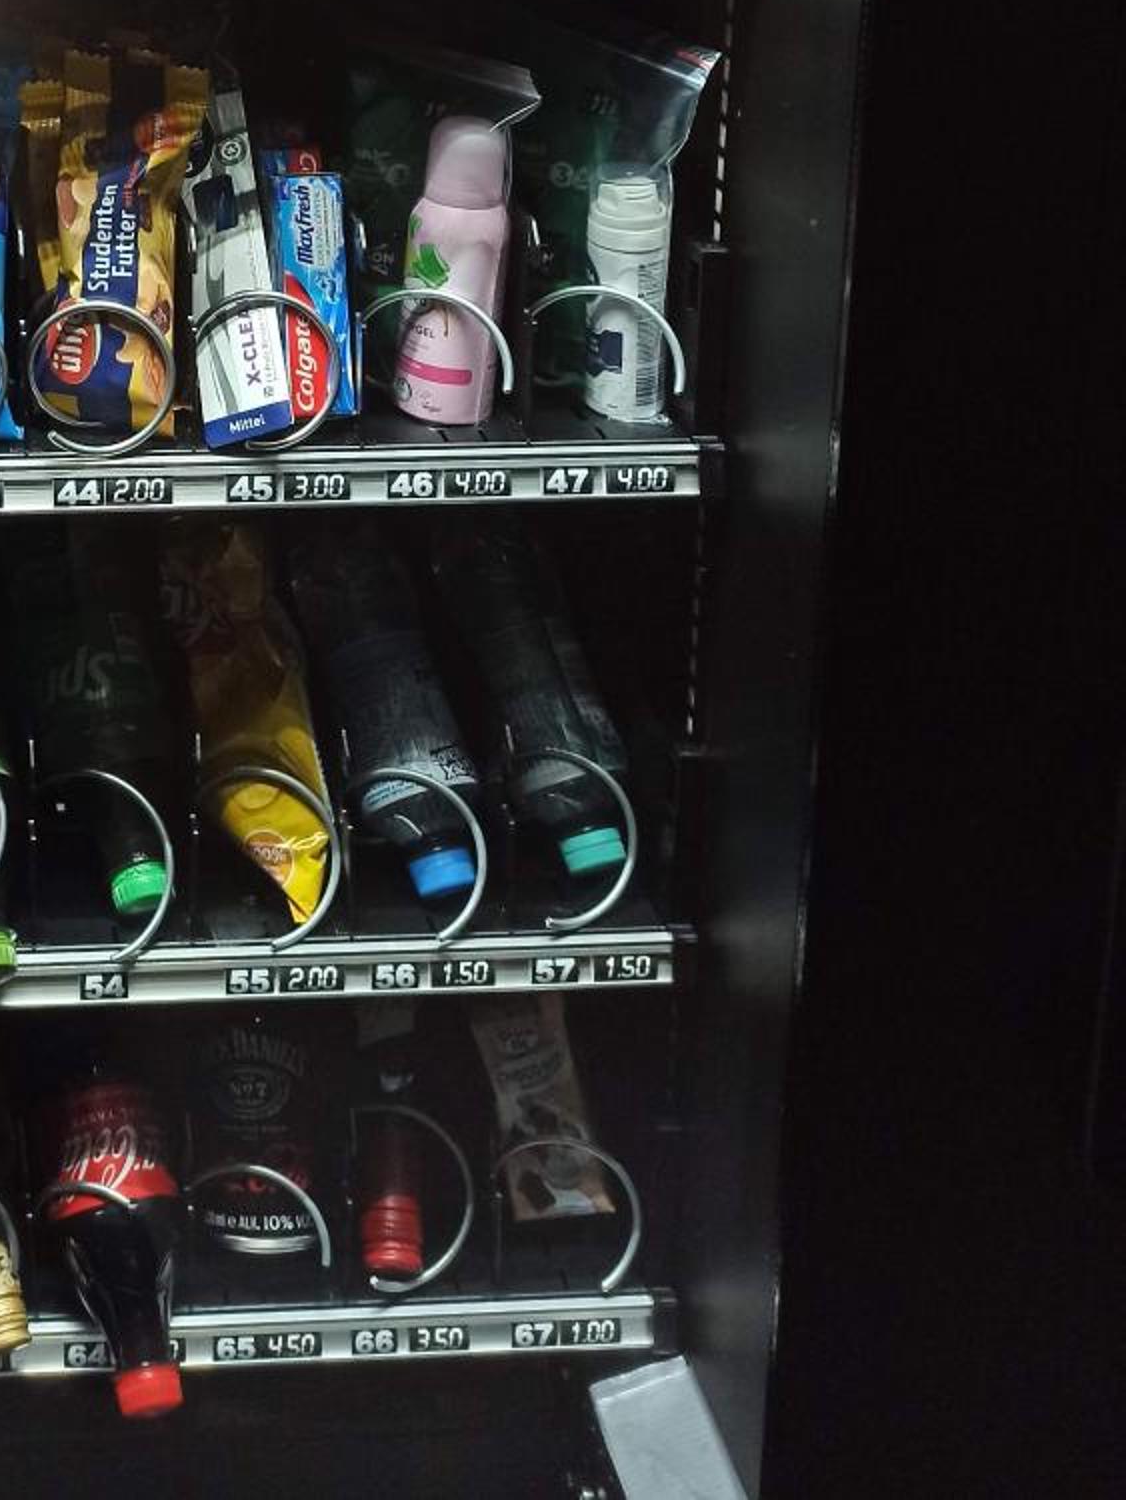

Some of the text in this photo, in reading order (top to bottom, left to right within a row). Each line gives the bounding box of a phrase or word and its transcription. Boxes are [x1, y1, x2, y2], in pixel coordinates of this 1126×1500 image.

[87, 183, 119, 294] Studenten
[111, 208, 138, 278] Futter
[294, 312, 316, 415] Colgate
[228, 414, 267, 436] Mittel
[57, 476, 166, 505] 44 2.00
[229, 473, 345, 501] 45 3.00
[390, 469, 506, 498] 46 4.00
[546, 466, 668, 494] 47 4.00
[229, 966, 339, 994] 55 2.00
[375, 961, 490, 989] 56 1.50
[535, 956, 651, 983] 57 1.50
[84, 974, 125, 999] 54
[262, 1214, 295, 1232] 10%
[217, 1333, 316, 1360] 65 4.50
[355, 1327, 464, 1354] 66 3.50
[515, 1319, 615, 1347] 67 1.00
[67, 1344, 108, 1368] 64
